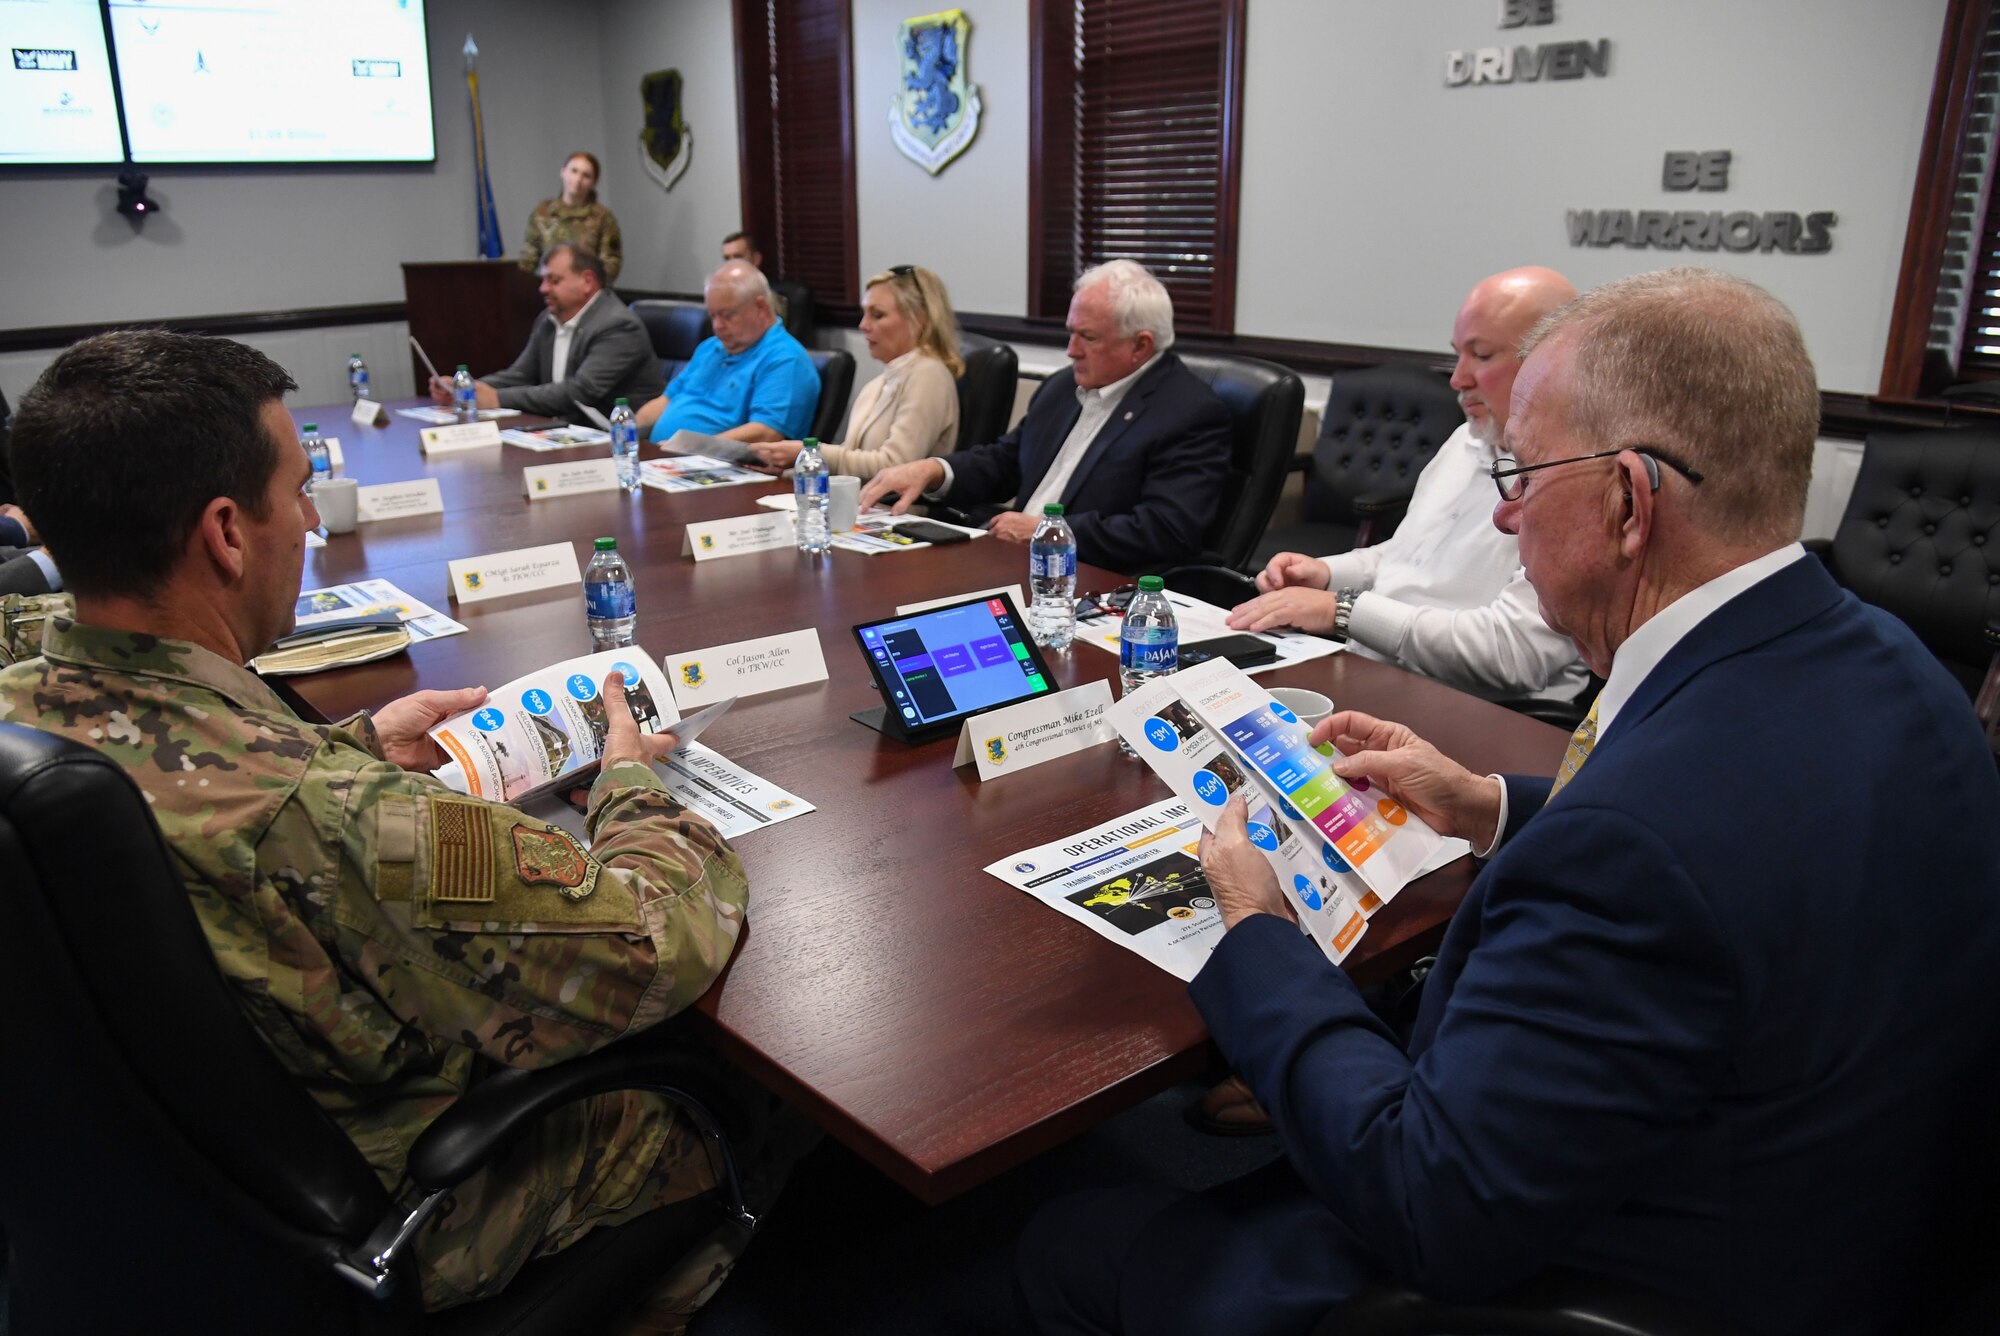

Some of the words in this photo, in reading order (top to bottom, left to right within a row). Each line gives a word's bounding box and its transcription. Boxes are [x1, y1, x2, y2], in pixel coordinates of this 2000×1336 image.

[1497, 0, 1555, 29] BE
[1443, 38, 1611, 87] DRIVEN
[1662, 150, 1732, 192] BE
[1566, 208, 1838, 255] WARRIORS
[726, 656, 740, 667] Col
[741, 653, 765, 664] Jason
[768, 647, 790, 658] Allen
[737, 667, 746, 675] 81
[748, 658, 785, 673] TRW/CC
[1144, 648, 1177, 662] DASAN
[530, 690, 546, 713] $930K
[574, 676, 591, 698] $3.6M
[1008, 720, 1061, 743] Congressman
[1063, 711, 1083, 726] Mike
[1085, 704, 1104, 720] Ezell
[1014, 742, 1025, 752] 4th
[1025, 731, 1064, 748] Congressional
[1065, 724, 1087, 736] District
[1087, 721, 1093, 730] of
[1093, 719, 1103, 727] MS
[1151, 725, 1170, 743] $3M
[688, 755, 758, 795] IMPERATIVES
[1198, 776, 1222, 797] $3.6M
[1062, 816, 1166, 857] OPERATIONAL
[1062, 871, 1096, 889] TRAINING
[1096, 862, 1123, 878] TODAY'S
[1122, 848, 1162, 870] WARFIGHTER
